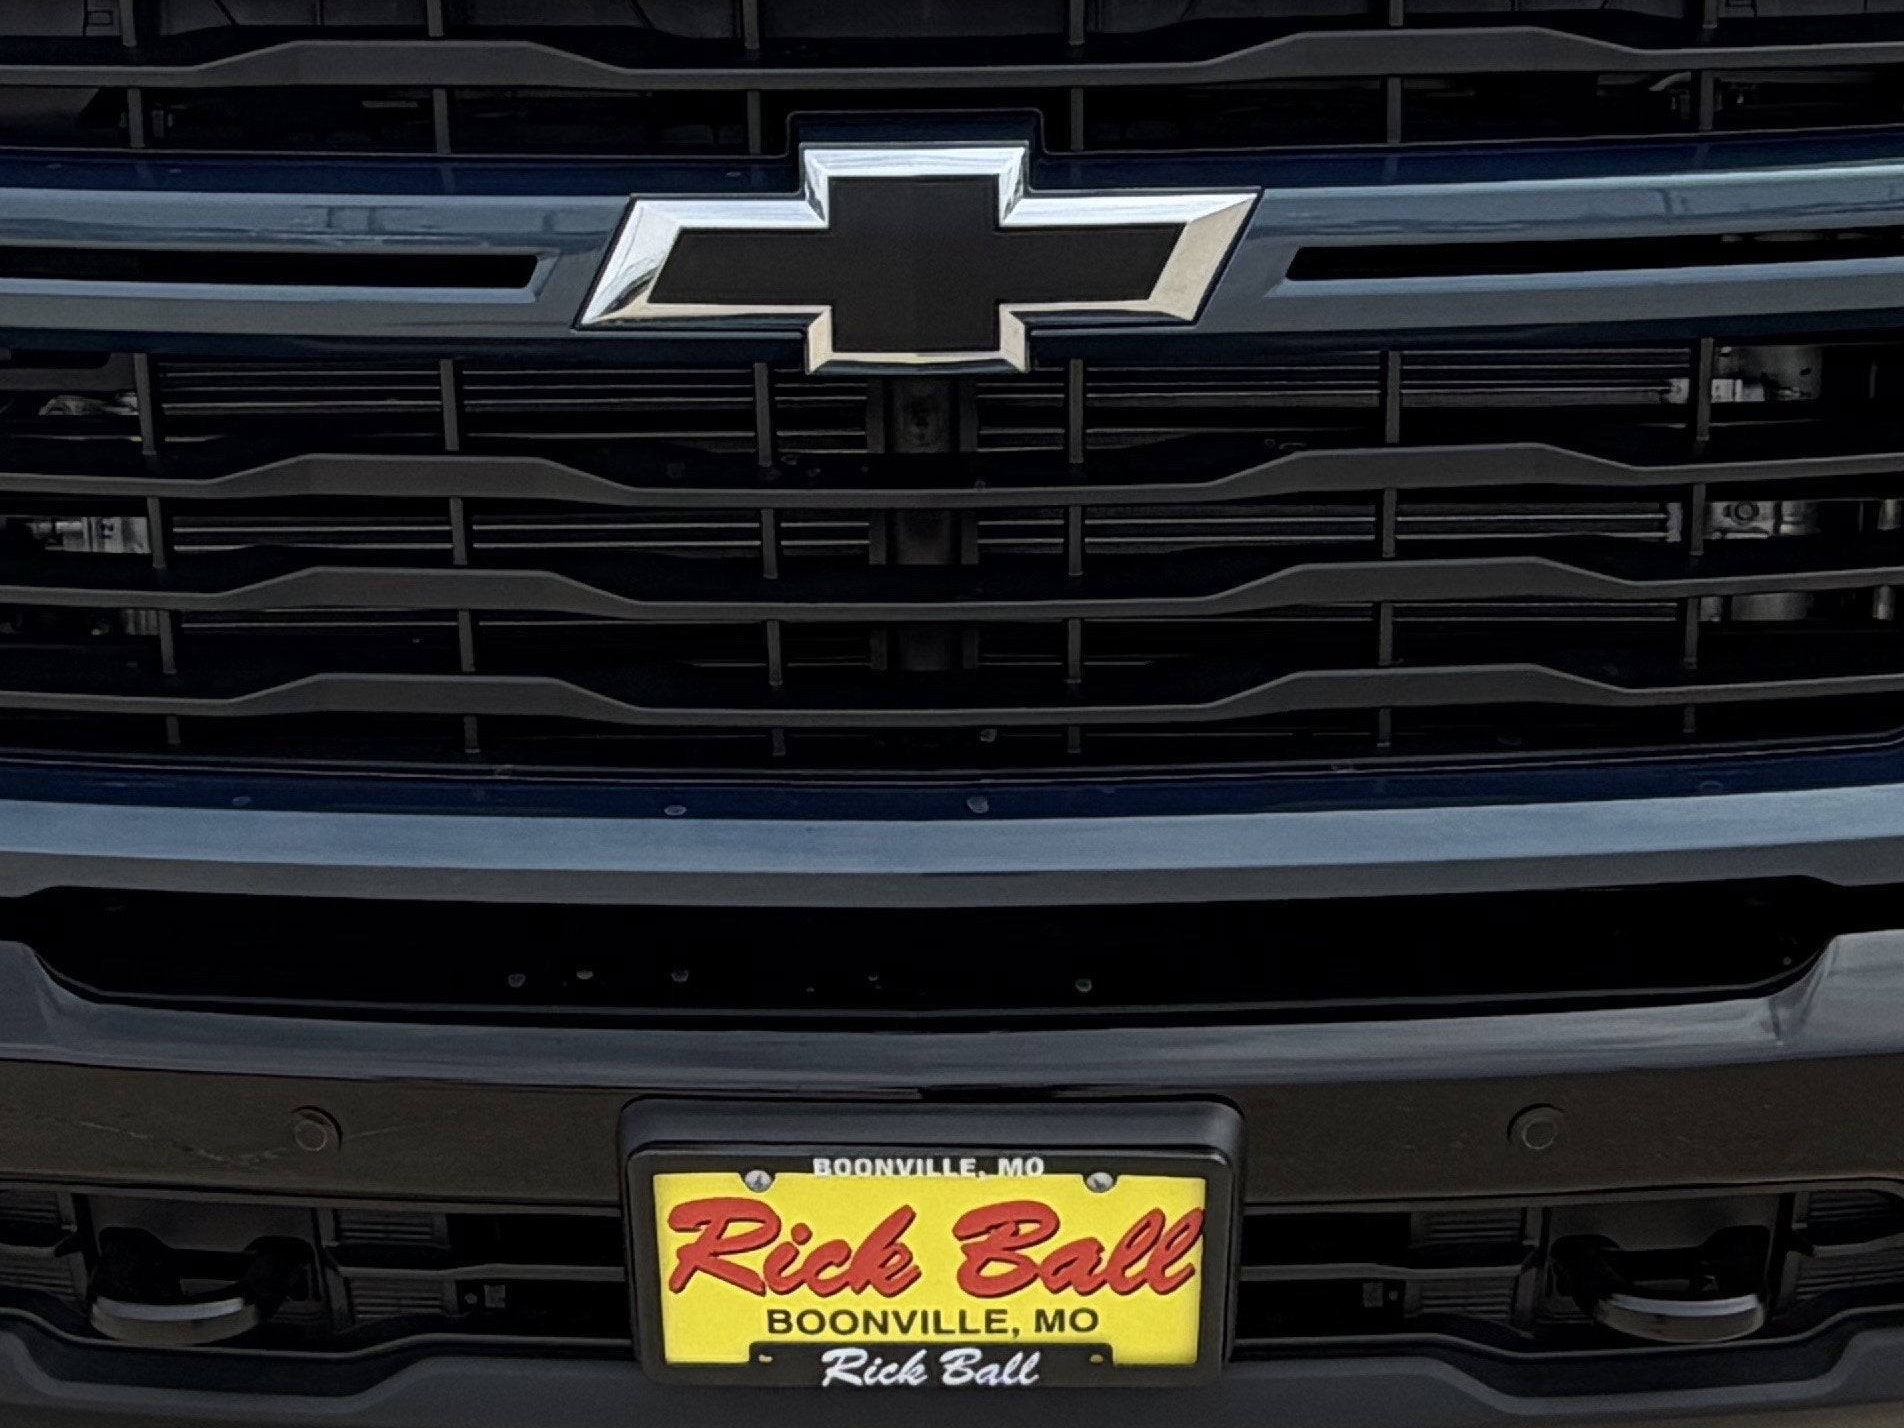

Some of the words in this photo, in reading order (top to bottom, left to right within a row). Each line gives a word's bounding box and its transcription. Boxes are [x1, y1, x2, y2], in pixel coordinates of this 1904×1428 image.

[813, 1157, 987, 1179] BOONVILLE,
[998, 1158, 1045, 1177] MO
[667, 1197, 922, 1298] Rick
[951, 1200, 1207, 1300] Ball
[766, 1308, 1021, 1339] BOONVILLE,
[1034, 1307, 1100, 1334] MO
[821, 1347, 929, 1388] Rick
[941, 1348, 1040, 1388] Ball
